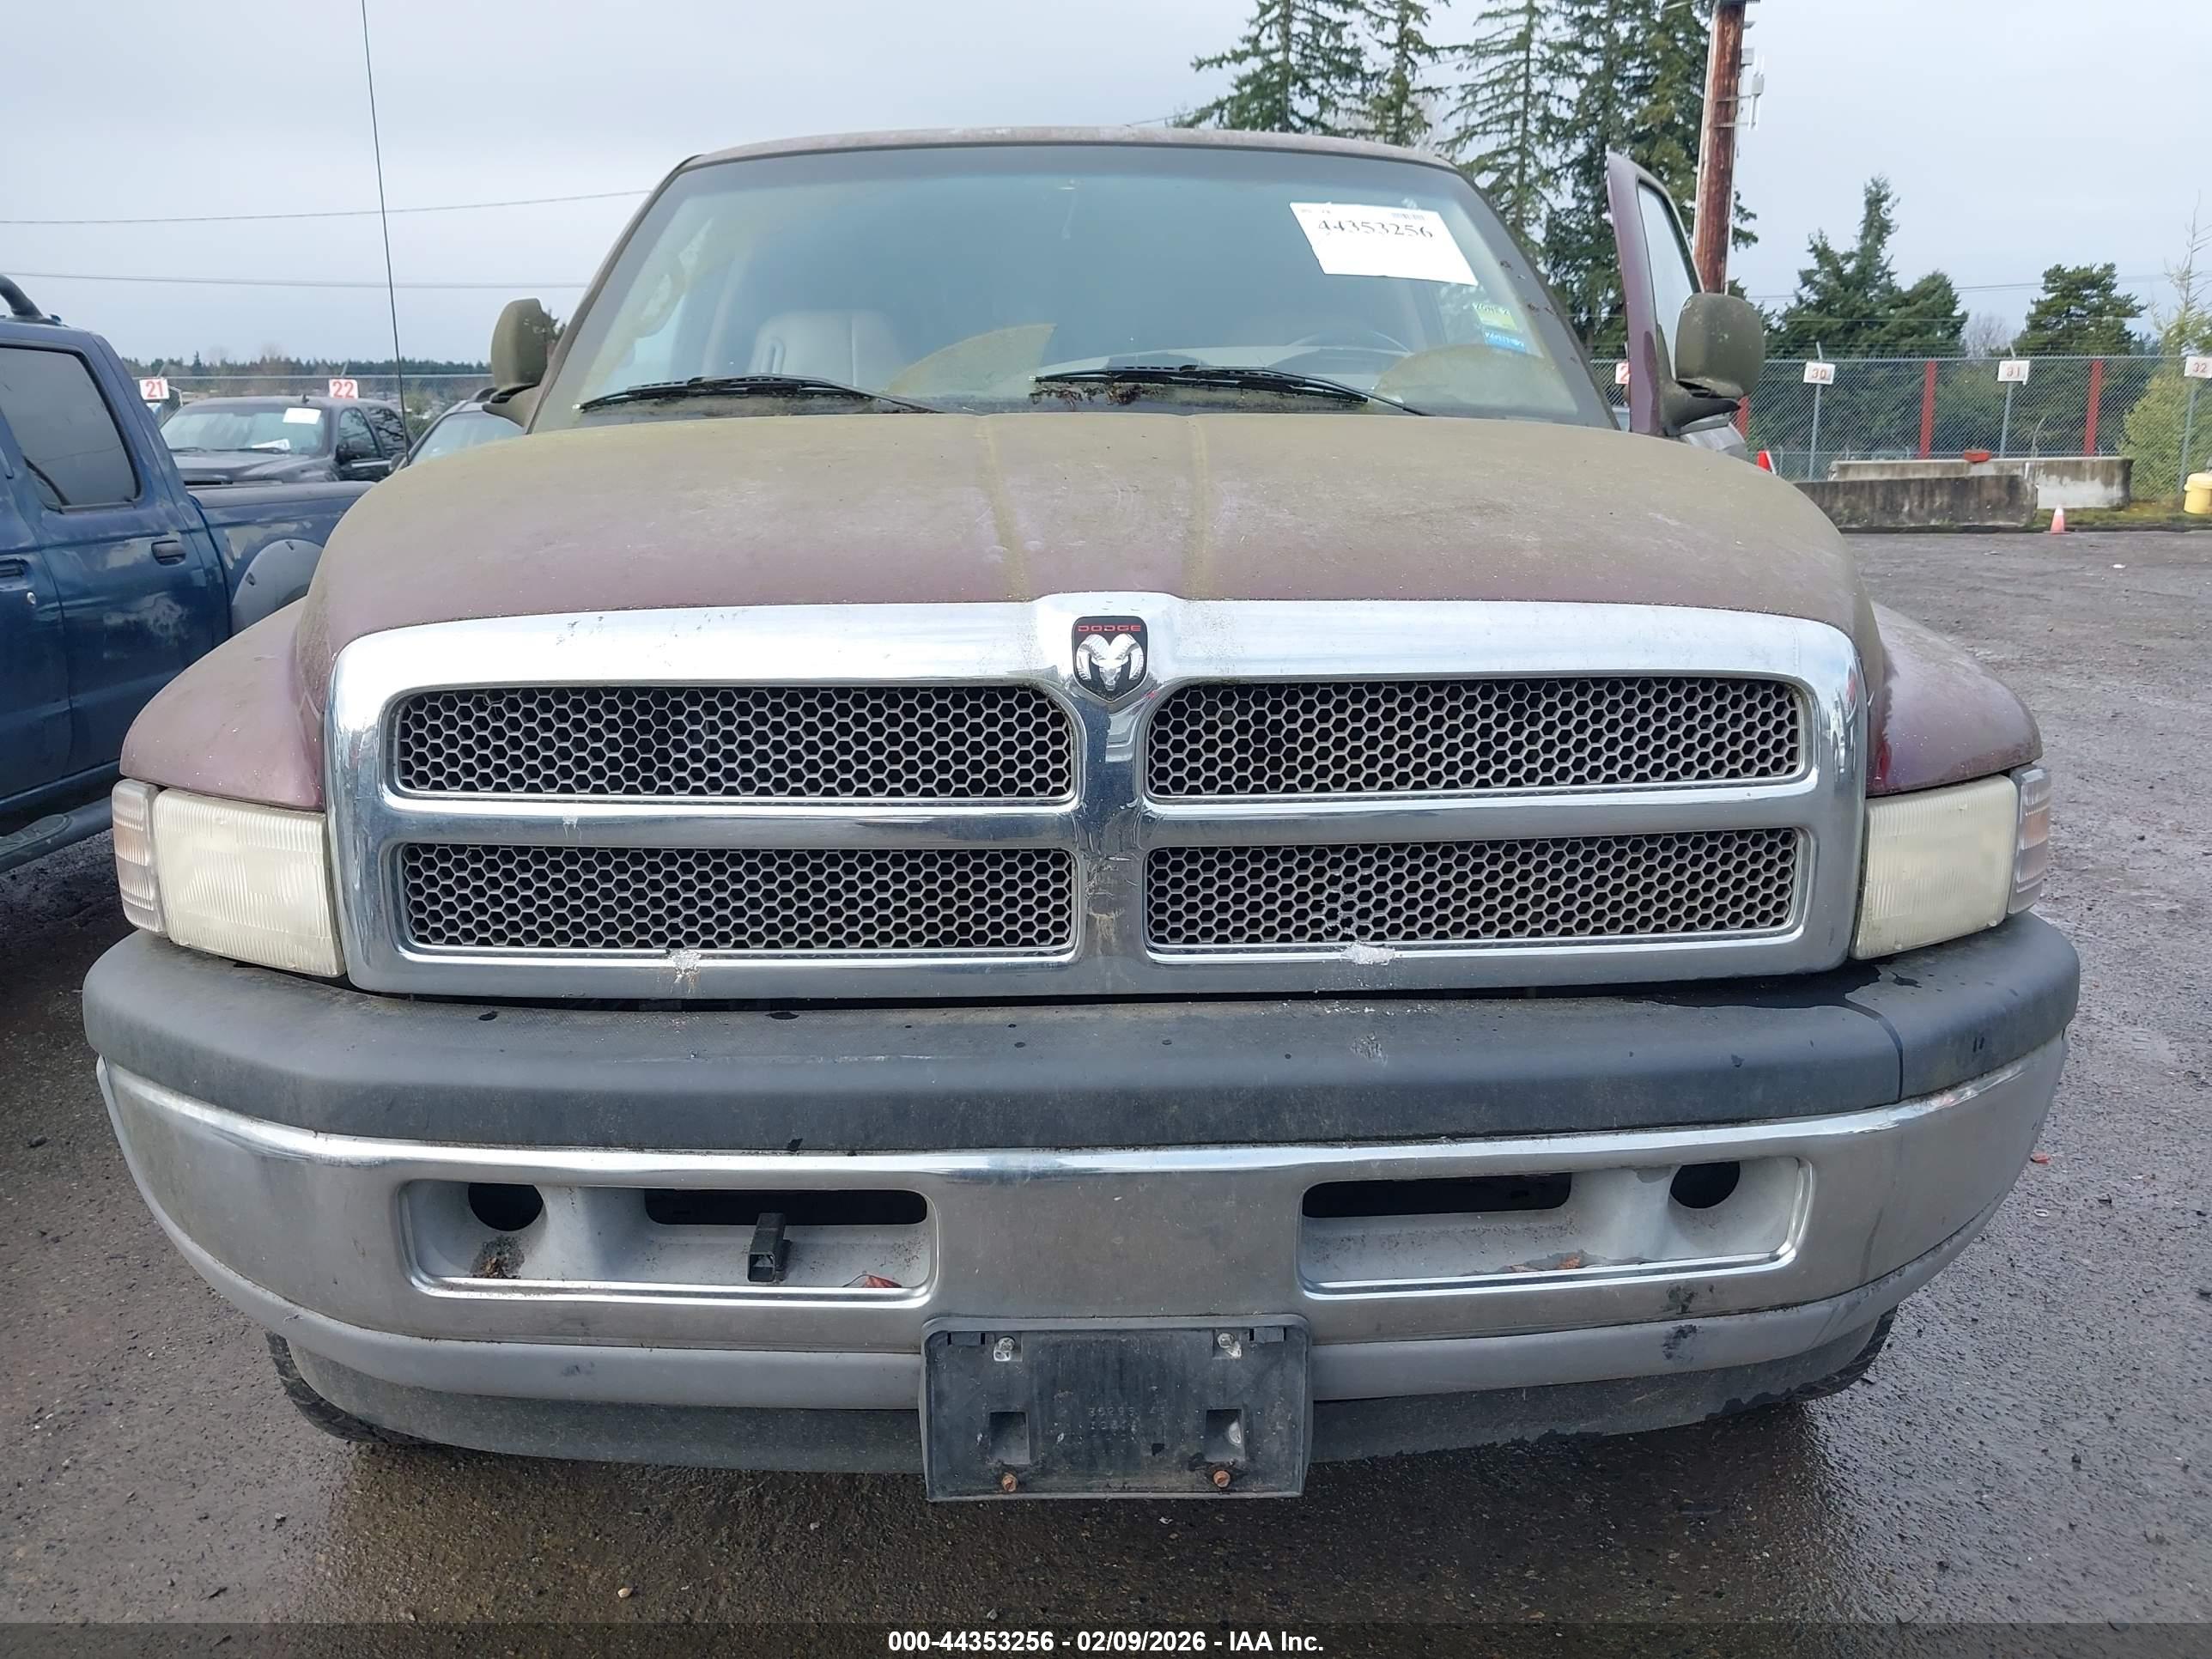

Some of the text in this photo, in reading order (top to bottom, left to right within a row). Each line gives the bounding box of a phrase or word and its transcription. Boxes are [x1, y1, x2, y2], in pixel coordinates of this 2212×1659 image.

[1318, 220, 1433, 240] 44353256
[1812, 368, 1827, 380] 30
[2193, 362, 2206, 374] 32
[145, 380, 163, 398] 21
[332, 380, 354, 398] 22
